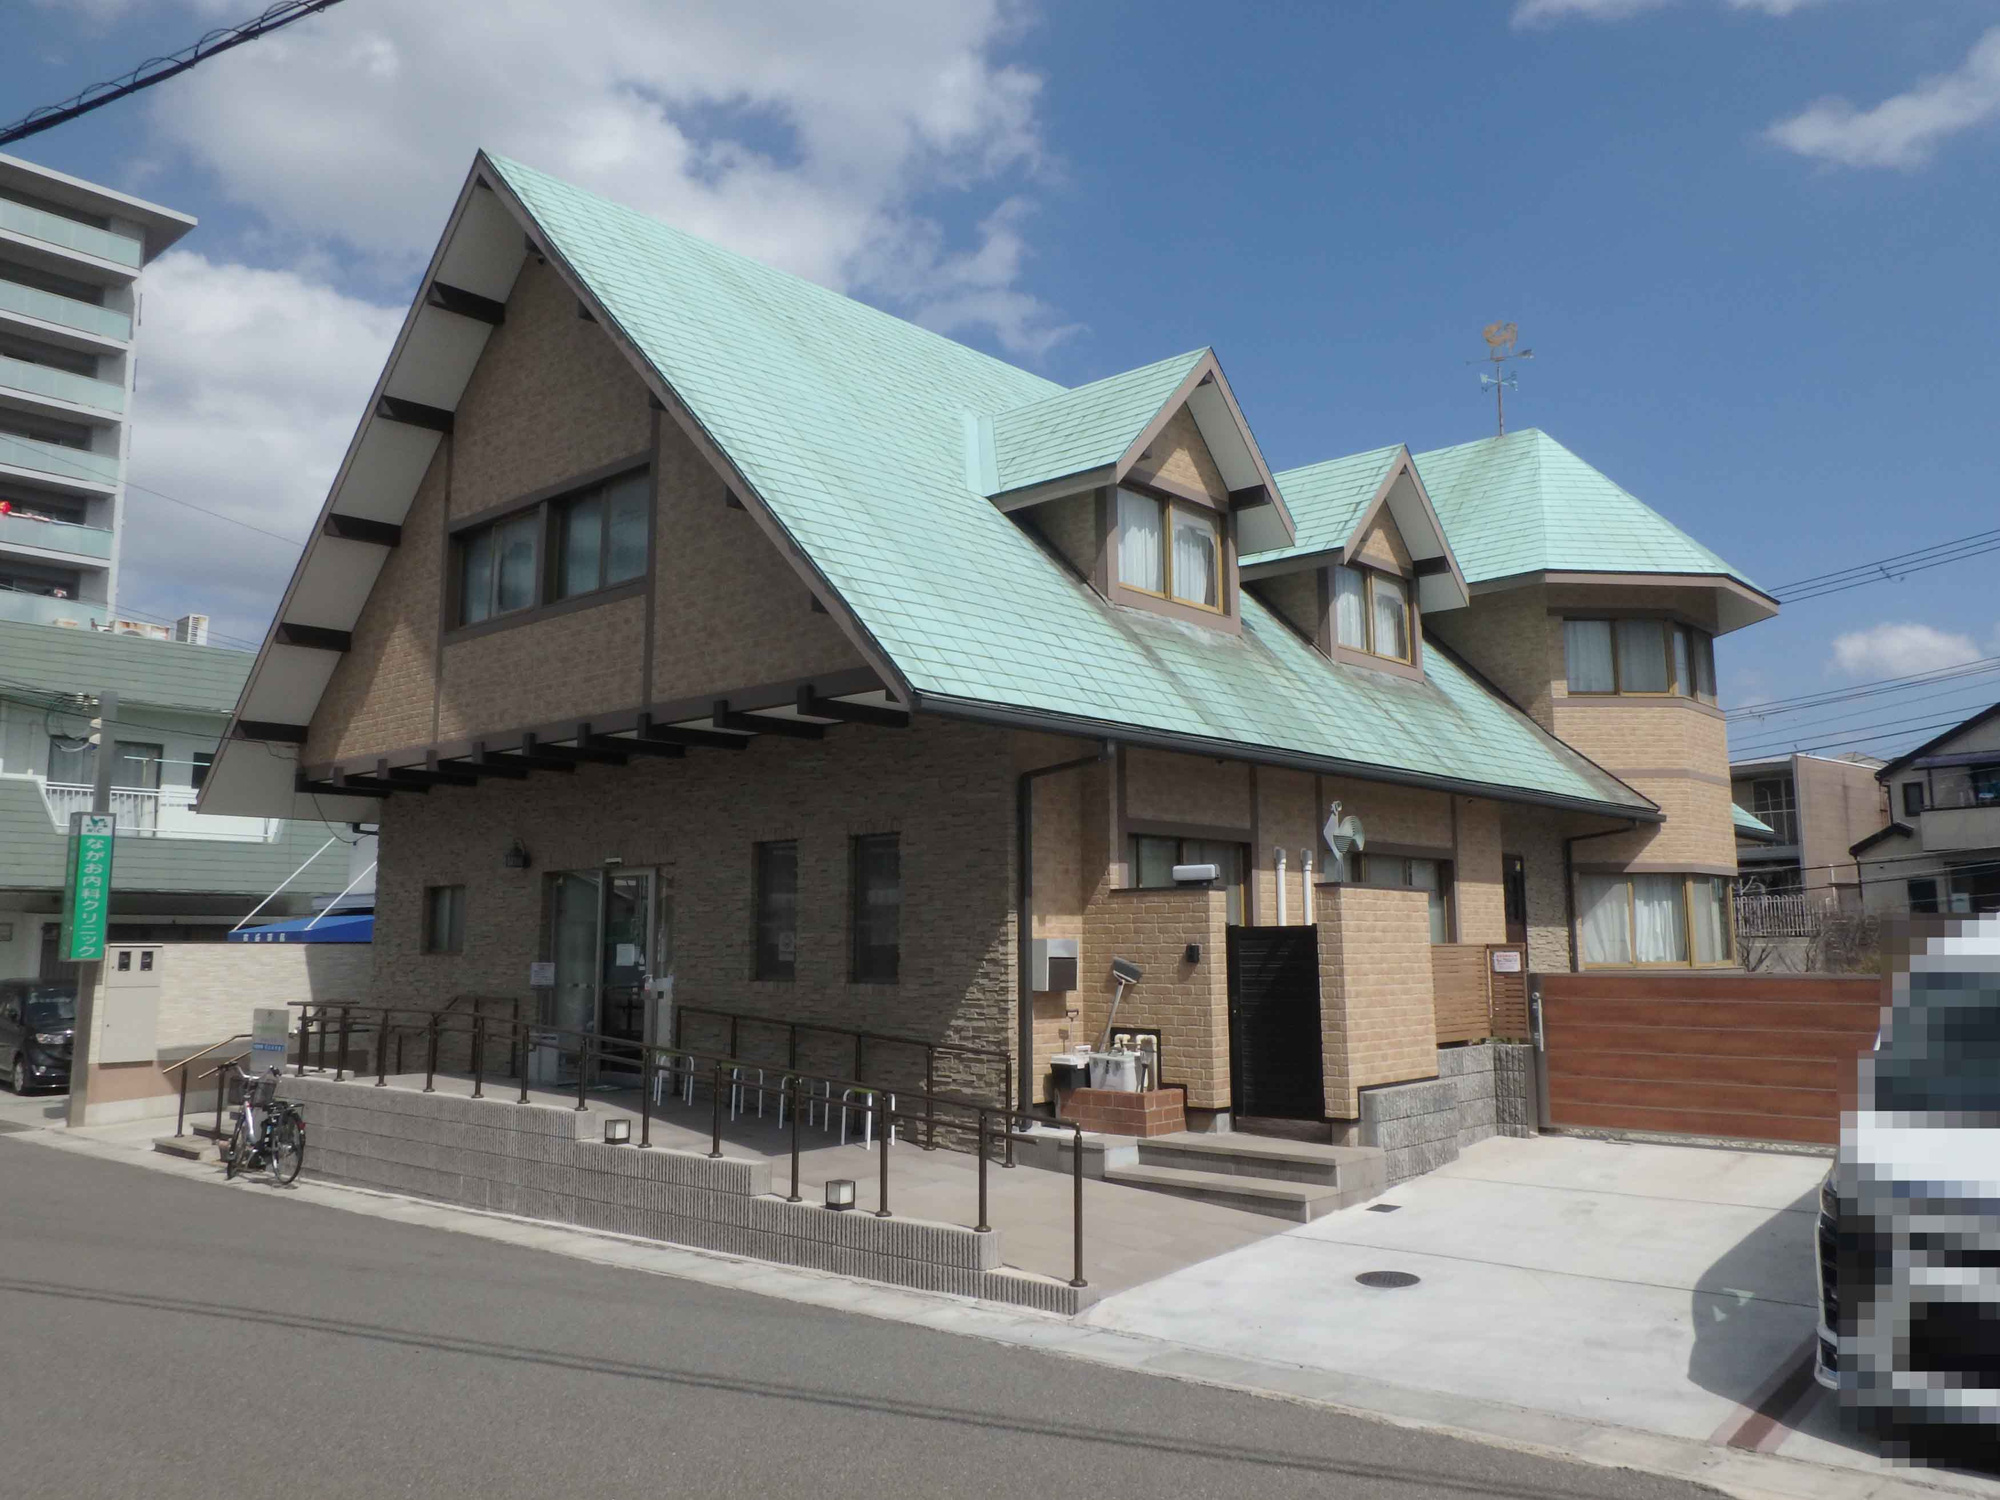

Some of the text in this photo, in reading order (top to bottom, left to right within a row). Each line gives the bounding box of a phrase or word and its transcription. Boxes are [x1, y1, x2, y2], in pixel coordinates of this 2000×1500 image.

[79, 838, 105, 957] ながお内科クリニック
